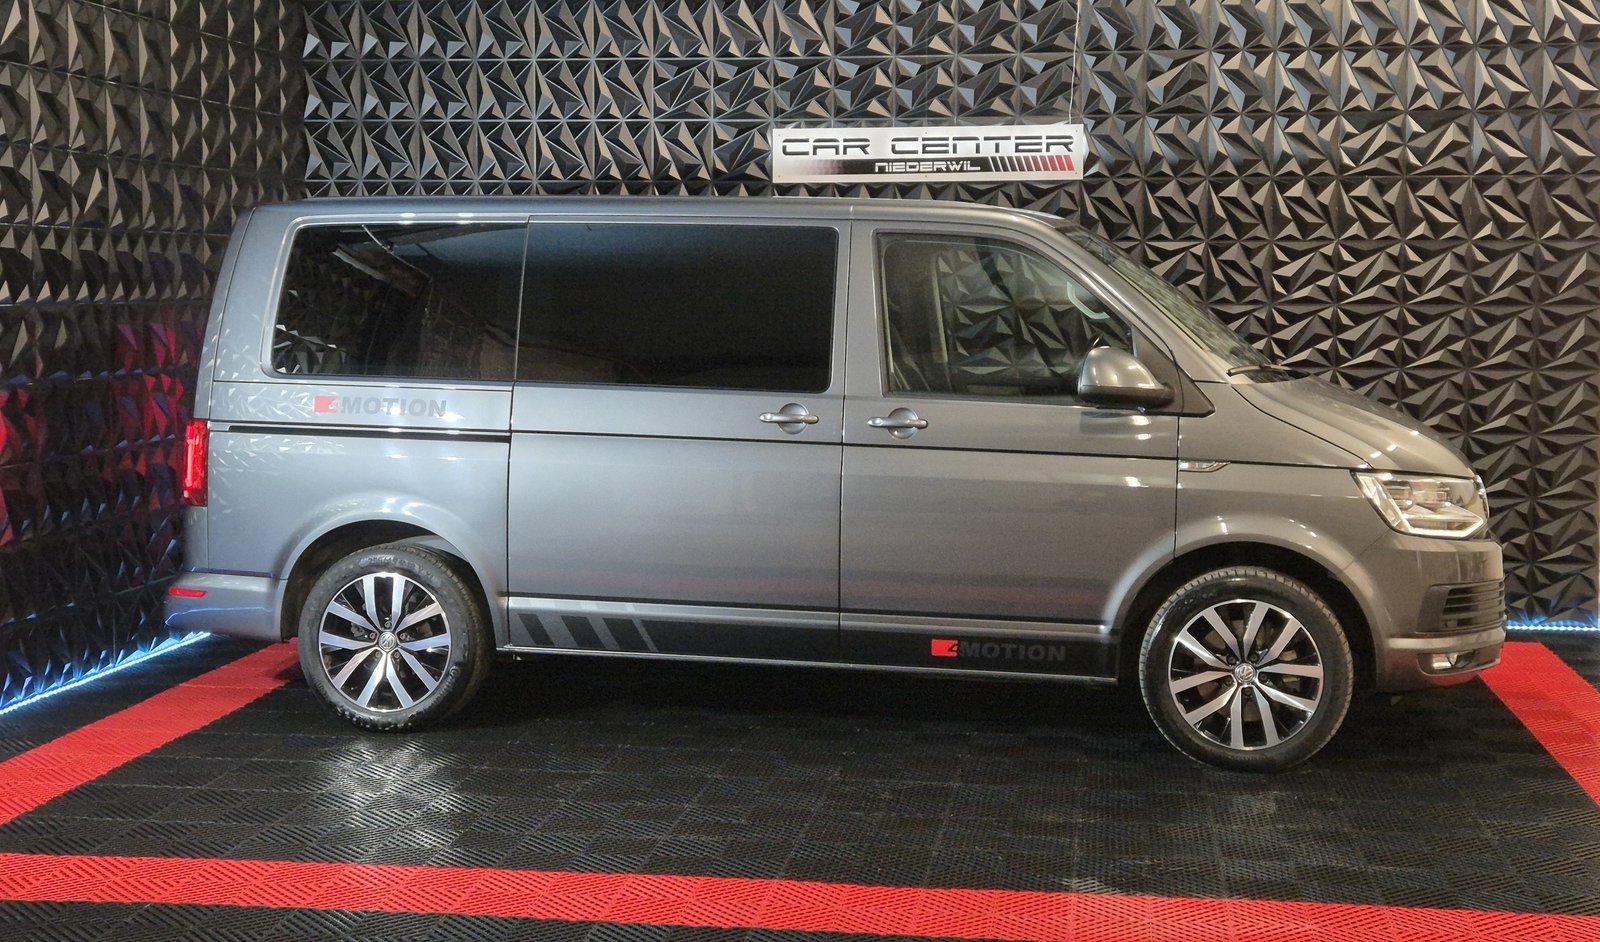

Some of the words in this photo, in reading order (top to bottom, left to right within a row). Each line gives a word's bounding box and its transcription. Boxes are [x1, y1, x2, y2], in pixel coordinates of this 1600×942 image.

[782, 138, 870, 155] CAR
[891, 135, 1074, 154] CENTER
[874, 160, 981, 173] NIEDERWIL
